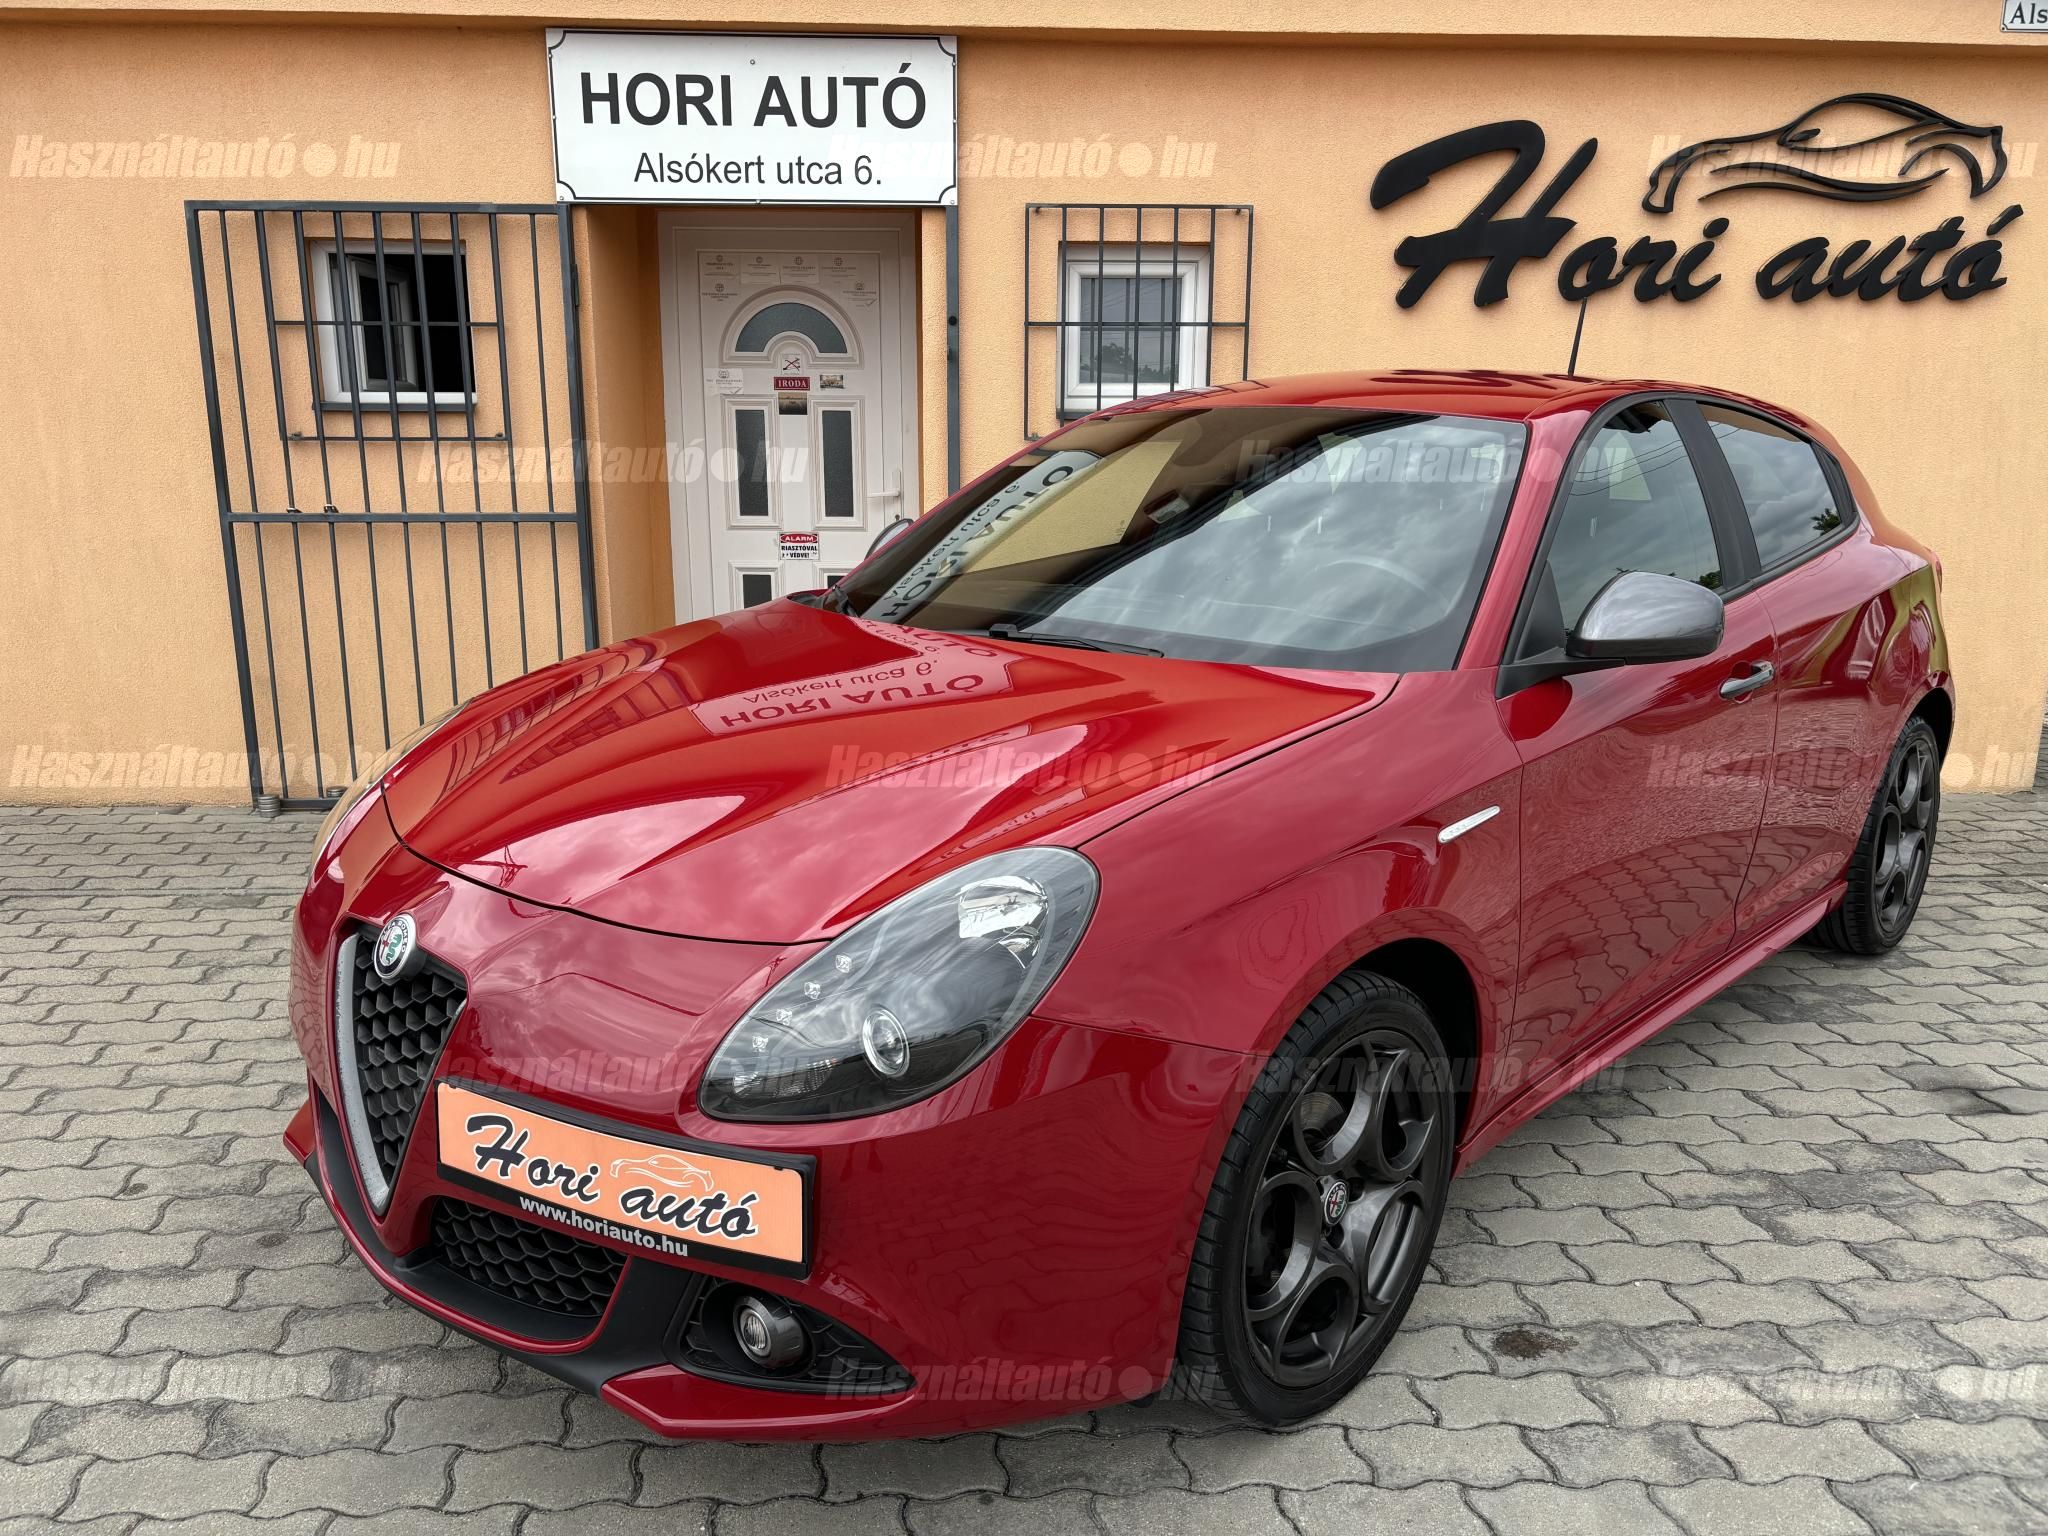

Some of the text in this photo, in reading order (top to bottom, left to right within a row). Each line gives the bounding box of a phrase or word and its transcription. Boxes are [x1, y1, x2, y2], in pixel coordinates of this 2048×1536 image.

[580, 63, 927, 129] HORI AUTÓ
[634, 152, 882, 185] Alsókert utca 6.
[1370, 119, 2025, 309] Hori autó
[778, 379, 807, 388] IRODA
[466, 1113, 759, 1240] Hori autó
[520, 1196, 689, 1258] www.horiauto.hu
